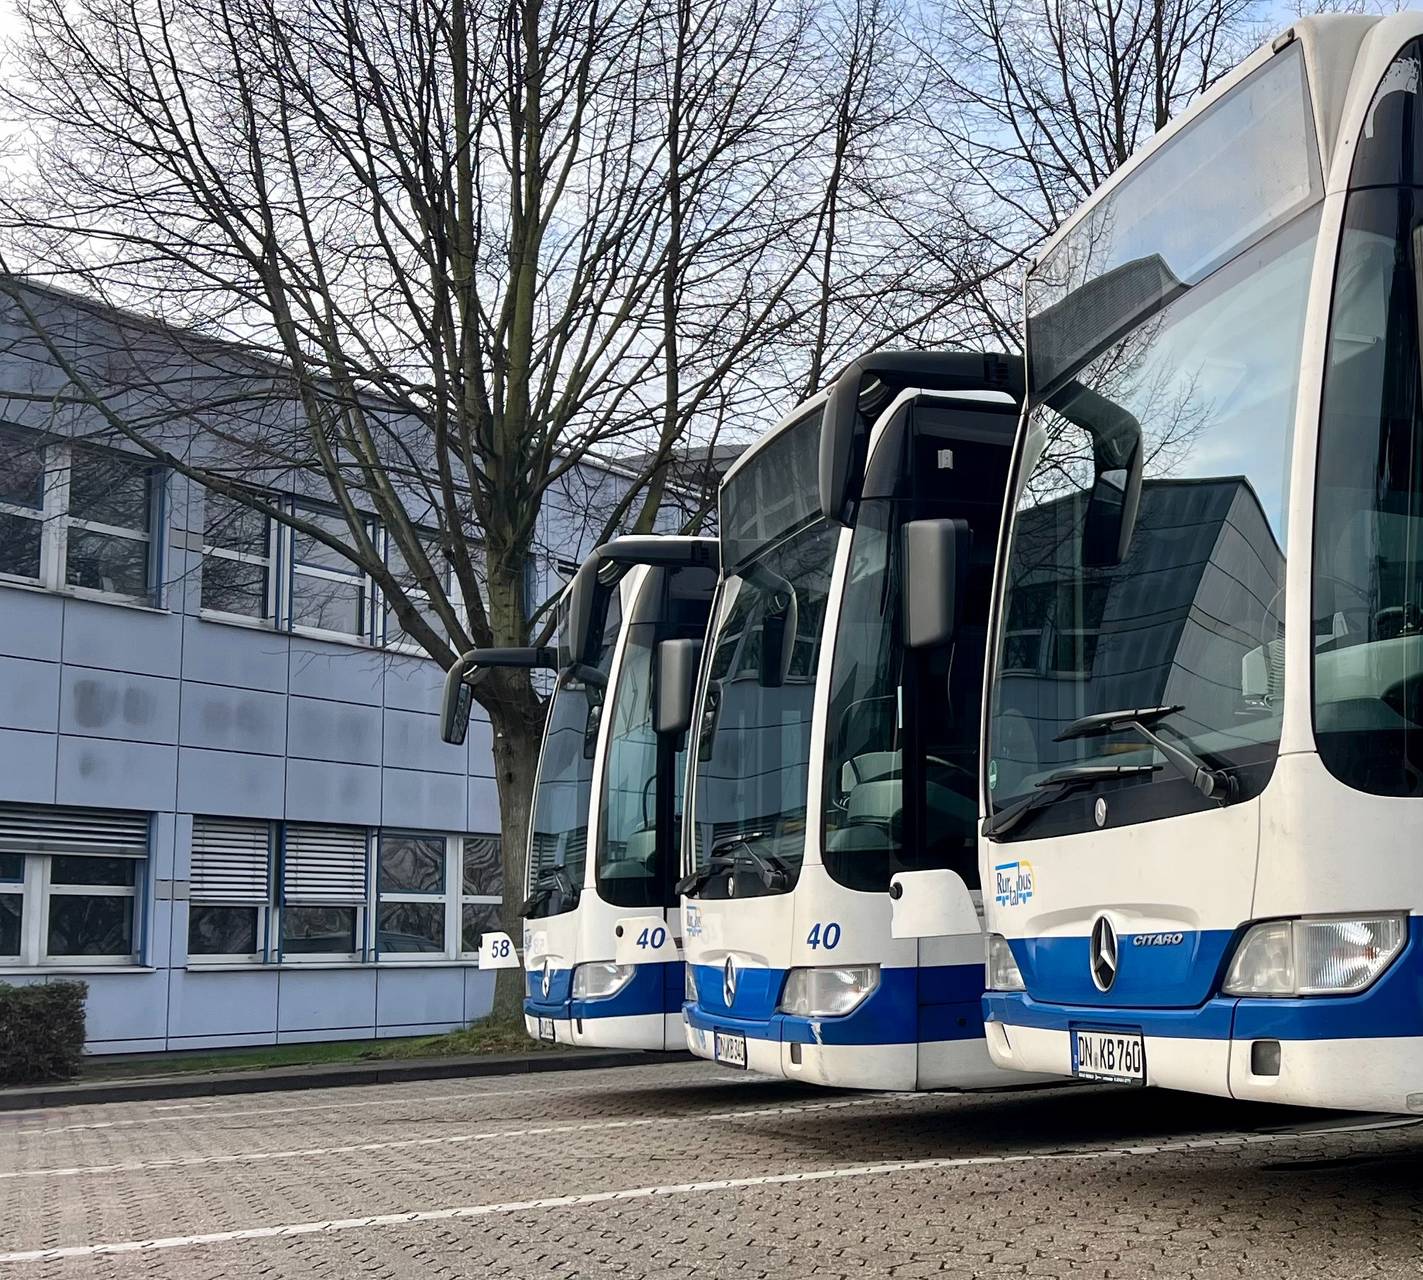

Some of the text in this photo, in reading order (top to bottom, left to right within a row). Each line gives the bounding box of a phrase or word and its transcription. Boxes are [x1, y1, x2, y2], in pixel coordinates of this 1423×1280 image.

[636, 927, 666, 950] 40
[806, 922, 841, 950] 40
[1132, 932, 1184, 946] CITARO
[491, 939, 511, 958] 58
[1078, 1036, 1141, 1073] DN KB 760
